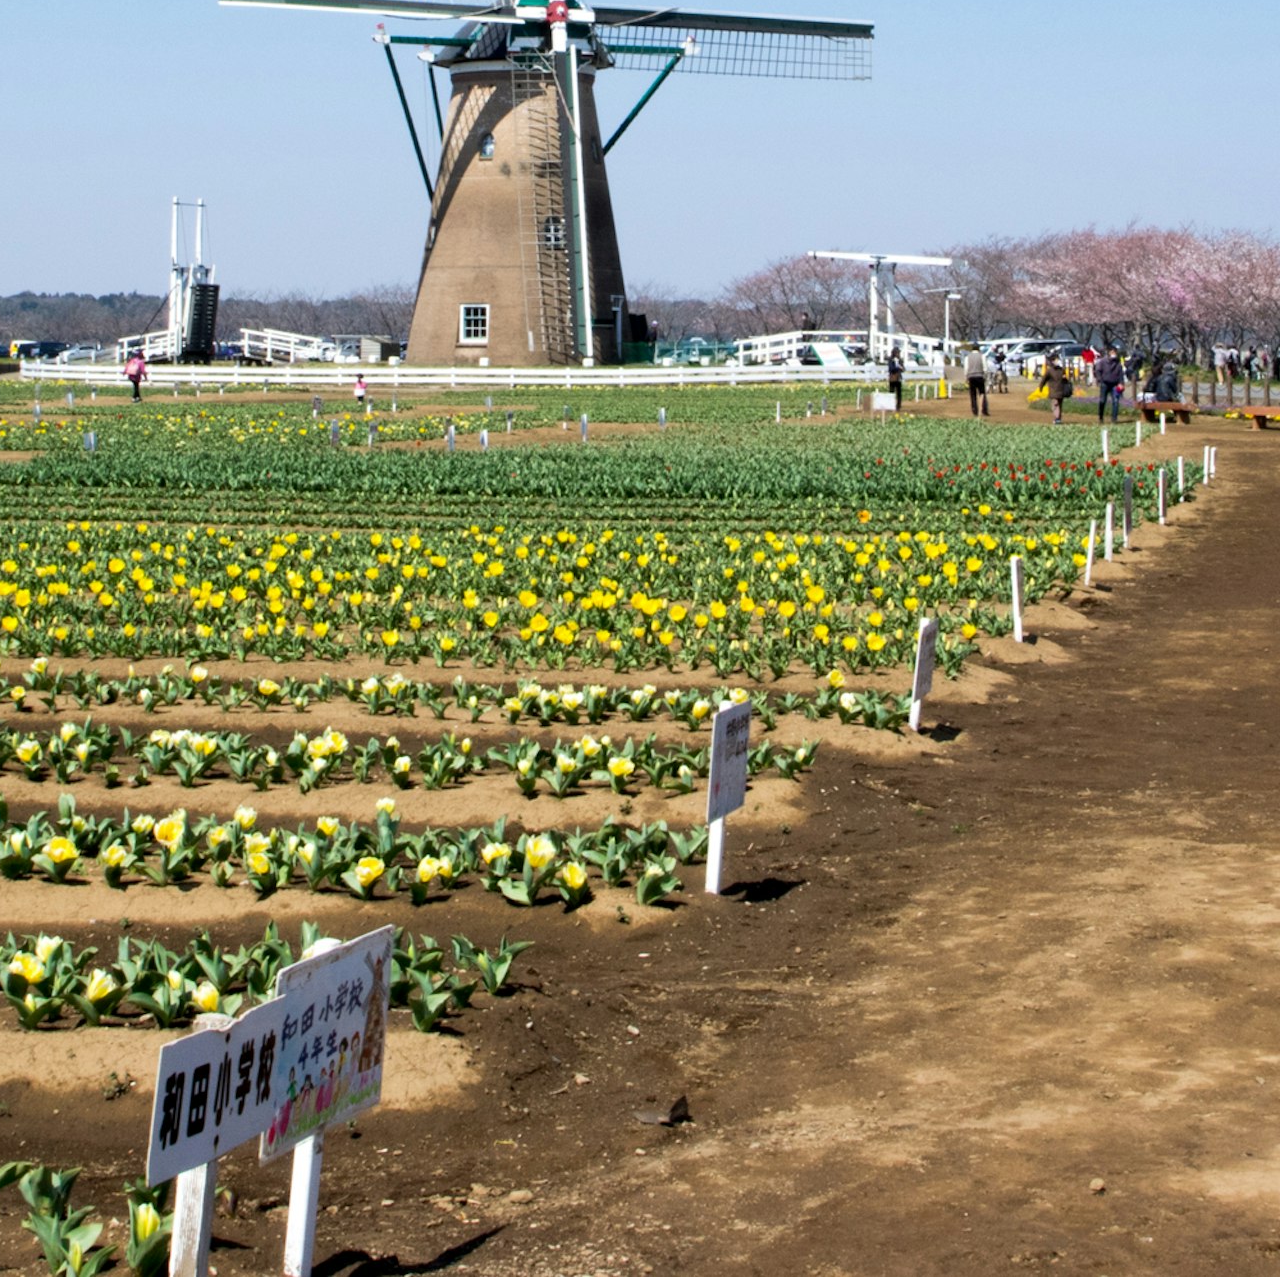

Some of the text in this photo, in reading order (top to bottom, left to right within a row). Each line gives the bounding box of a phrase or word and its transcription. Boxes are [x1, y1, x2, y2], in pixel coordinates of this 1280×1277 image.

[281, 977, 363, 1052] 和田小学校
[298, 1028, 338, 1071] 4年生
[159, 1029, 276, 1151] 和田小学校
